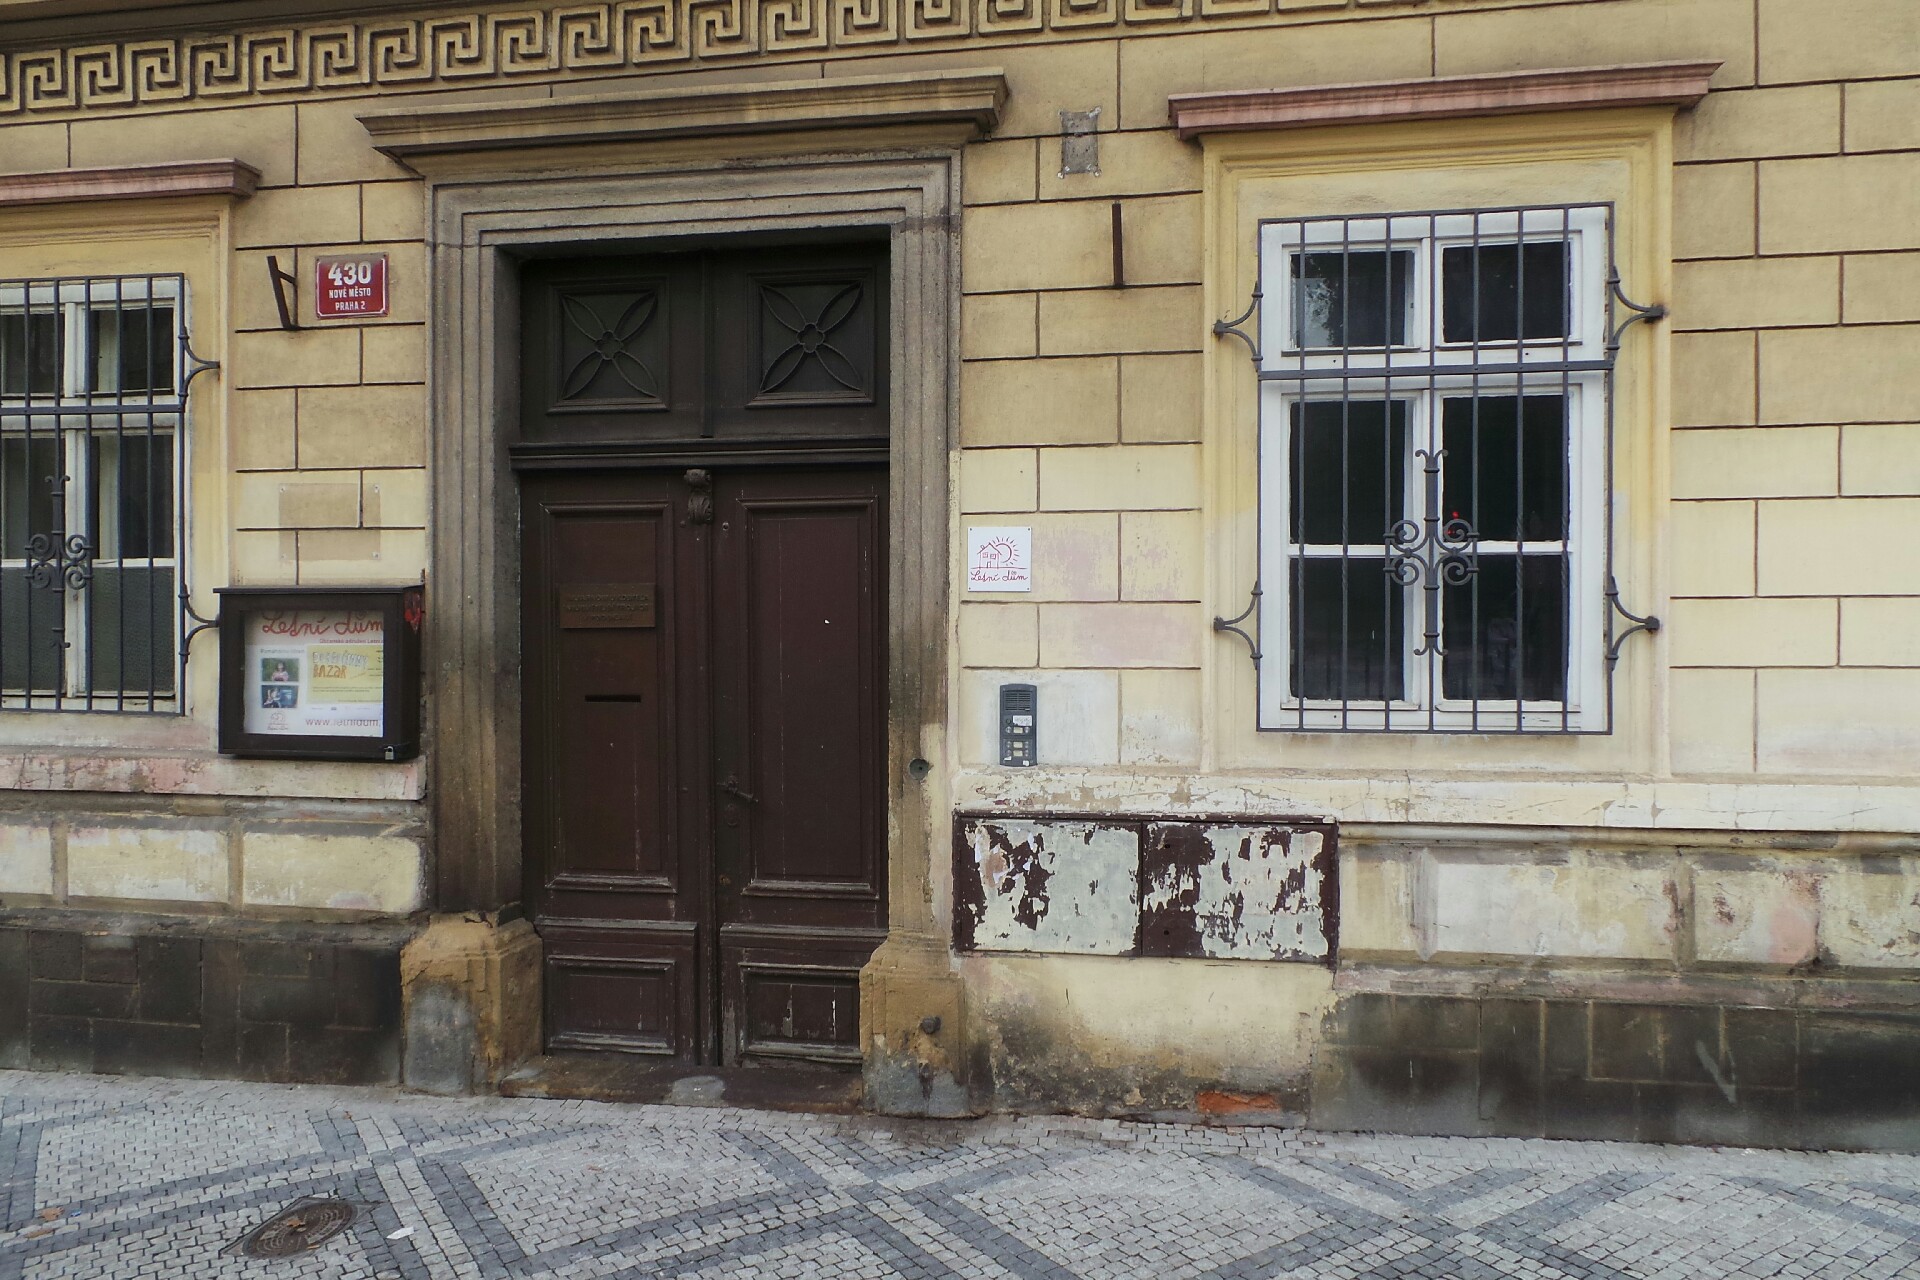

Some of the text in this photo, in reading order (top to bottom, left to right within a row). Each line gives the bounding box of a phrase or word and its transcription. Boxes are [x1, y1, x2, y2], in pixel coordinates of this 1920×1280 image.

[329, 262, 371, 285] 430
[328, 285, 371, 298] NOVÉ MĚSTO
[335, 300, 366, 311] PRAHA 2
